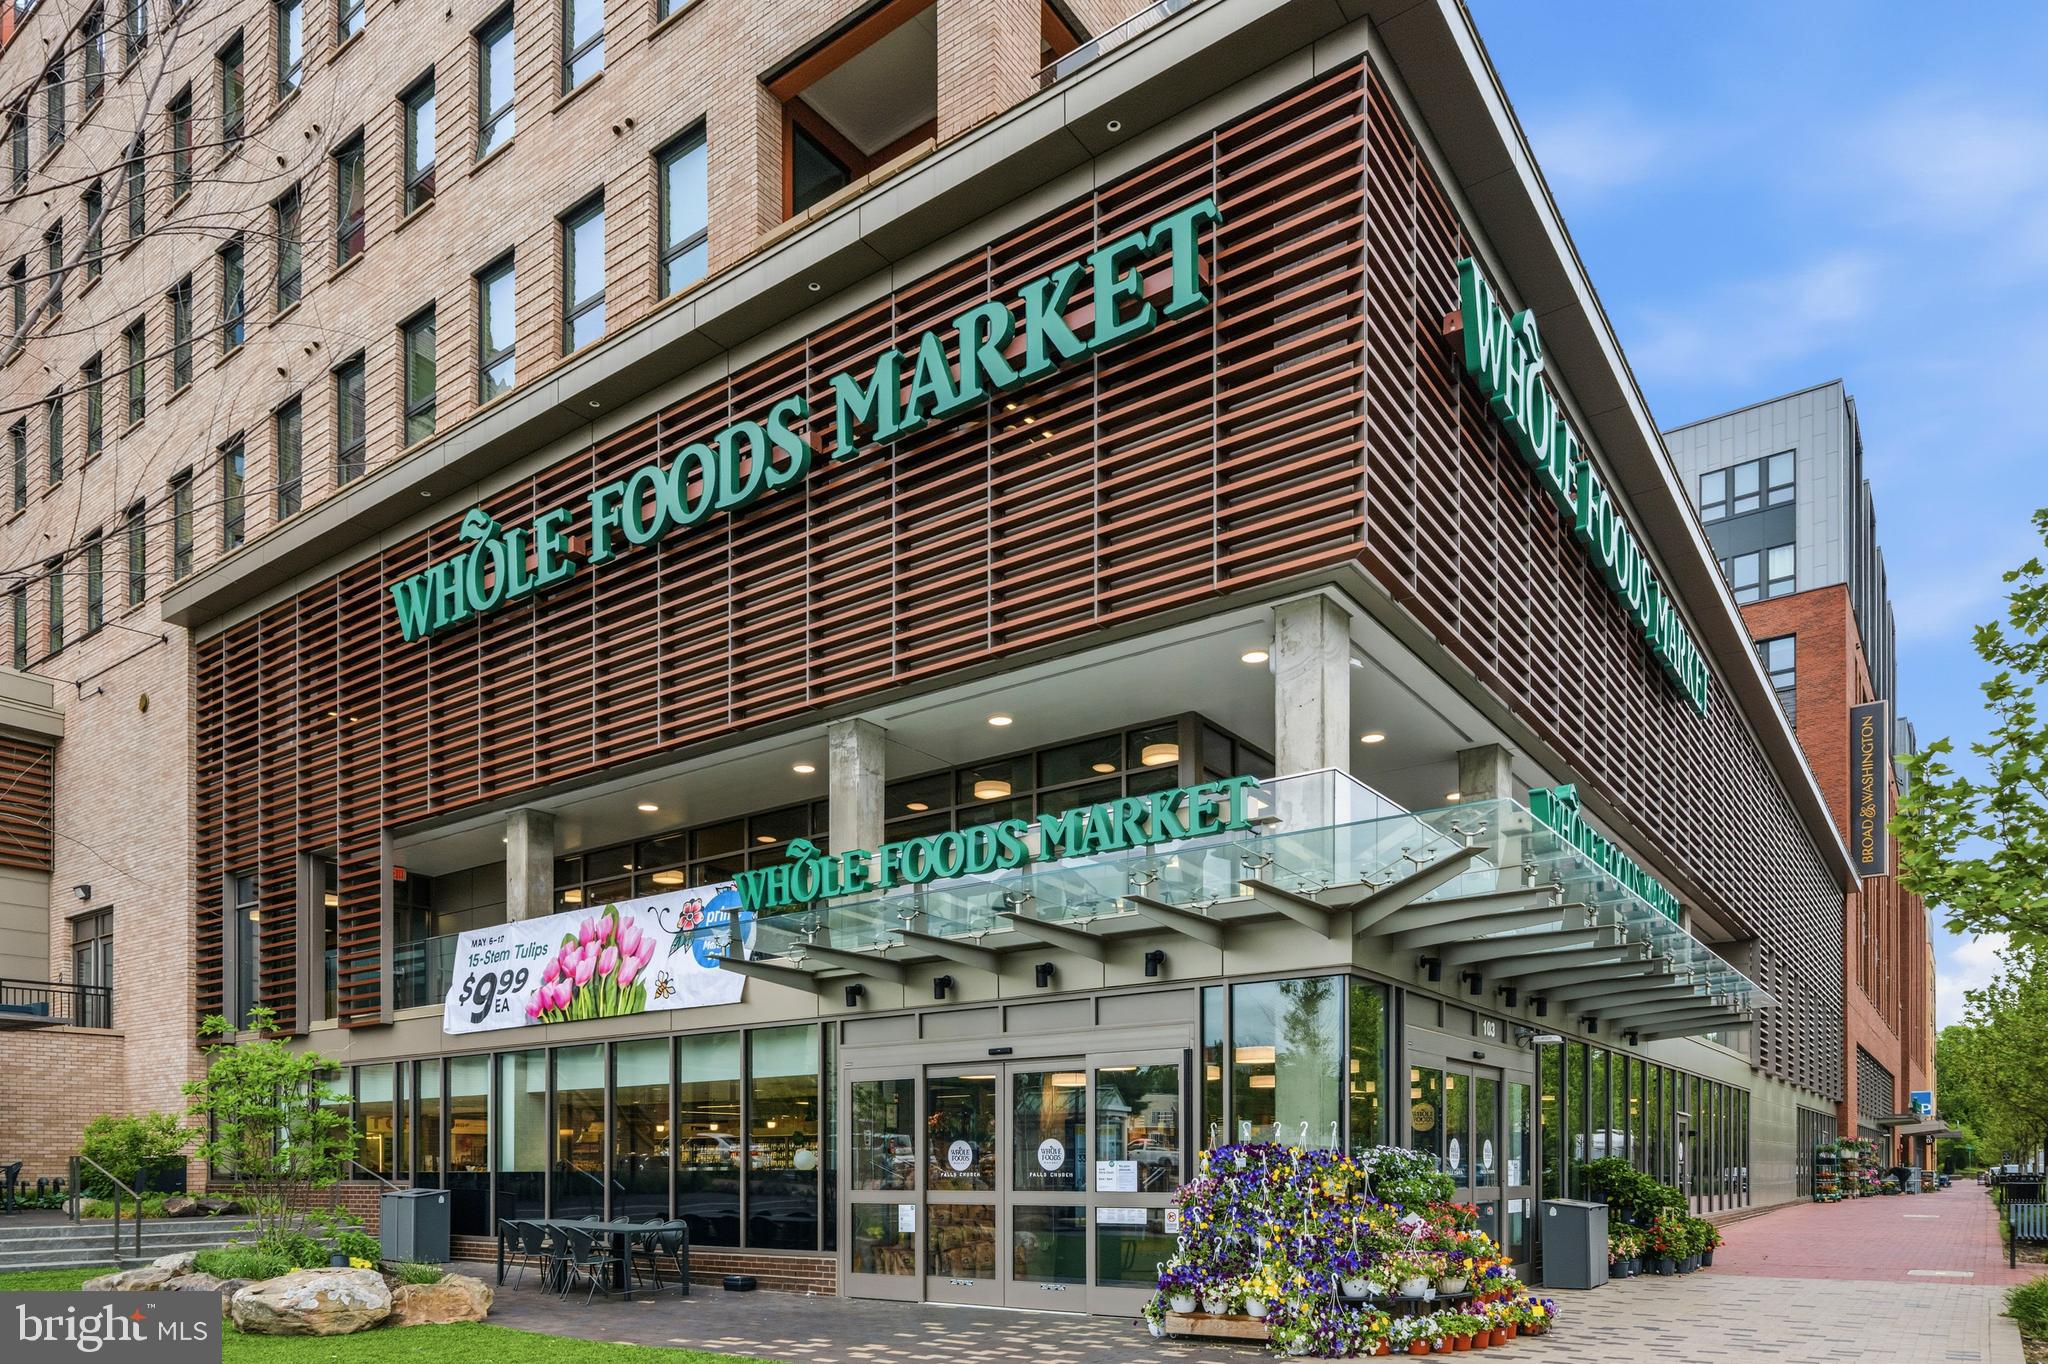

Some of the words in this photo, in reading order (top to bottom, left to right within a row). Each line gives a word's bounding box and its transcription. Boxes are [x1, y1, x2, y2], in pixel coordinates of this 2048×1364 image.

[390, 508, 576, 642] WHOLE
[587, 394, 811, 566] FOODS
[830, 198, 1222, 464] MARKET
[1457, 257, 1578, 517] WHOLE
[1575, 460, 1652, 630] FOODS
[1644, 580, 1711, 720] MARKET
[1861, 715, 1874, 804] WASHINGTON
[1860, 804, 1876, 818] &
[732, 837, 871, 911] WHOLE
[878, 818, 1028, 889] FOODS
[1037, 775, 1260, 863] MARKET
[1861, 819, 1874, 863] BROAD
[468, 949, 511, 968] 15-Stem
[515, 942, 549, 960] Tulips
[471, 938, 487, 948] MAY
[495, 998, 510, 1013] EA
[1483, 1019, 1496, 1038] 103
